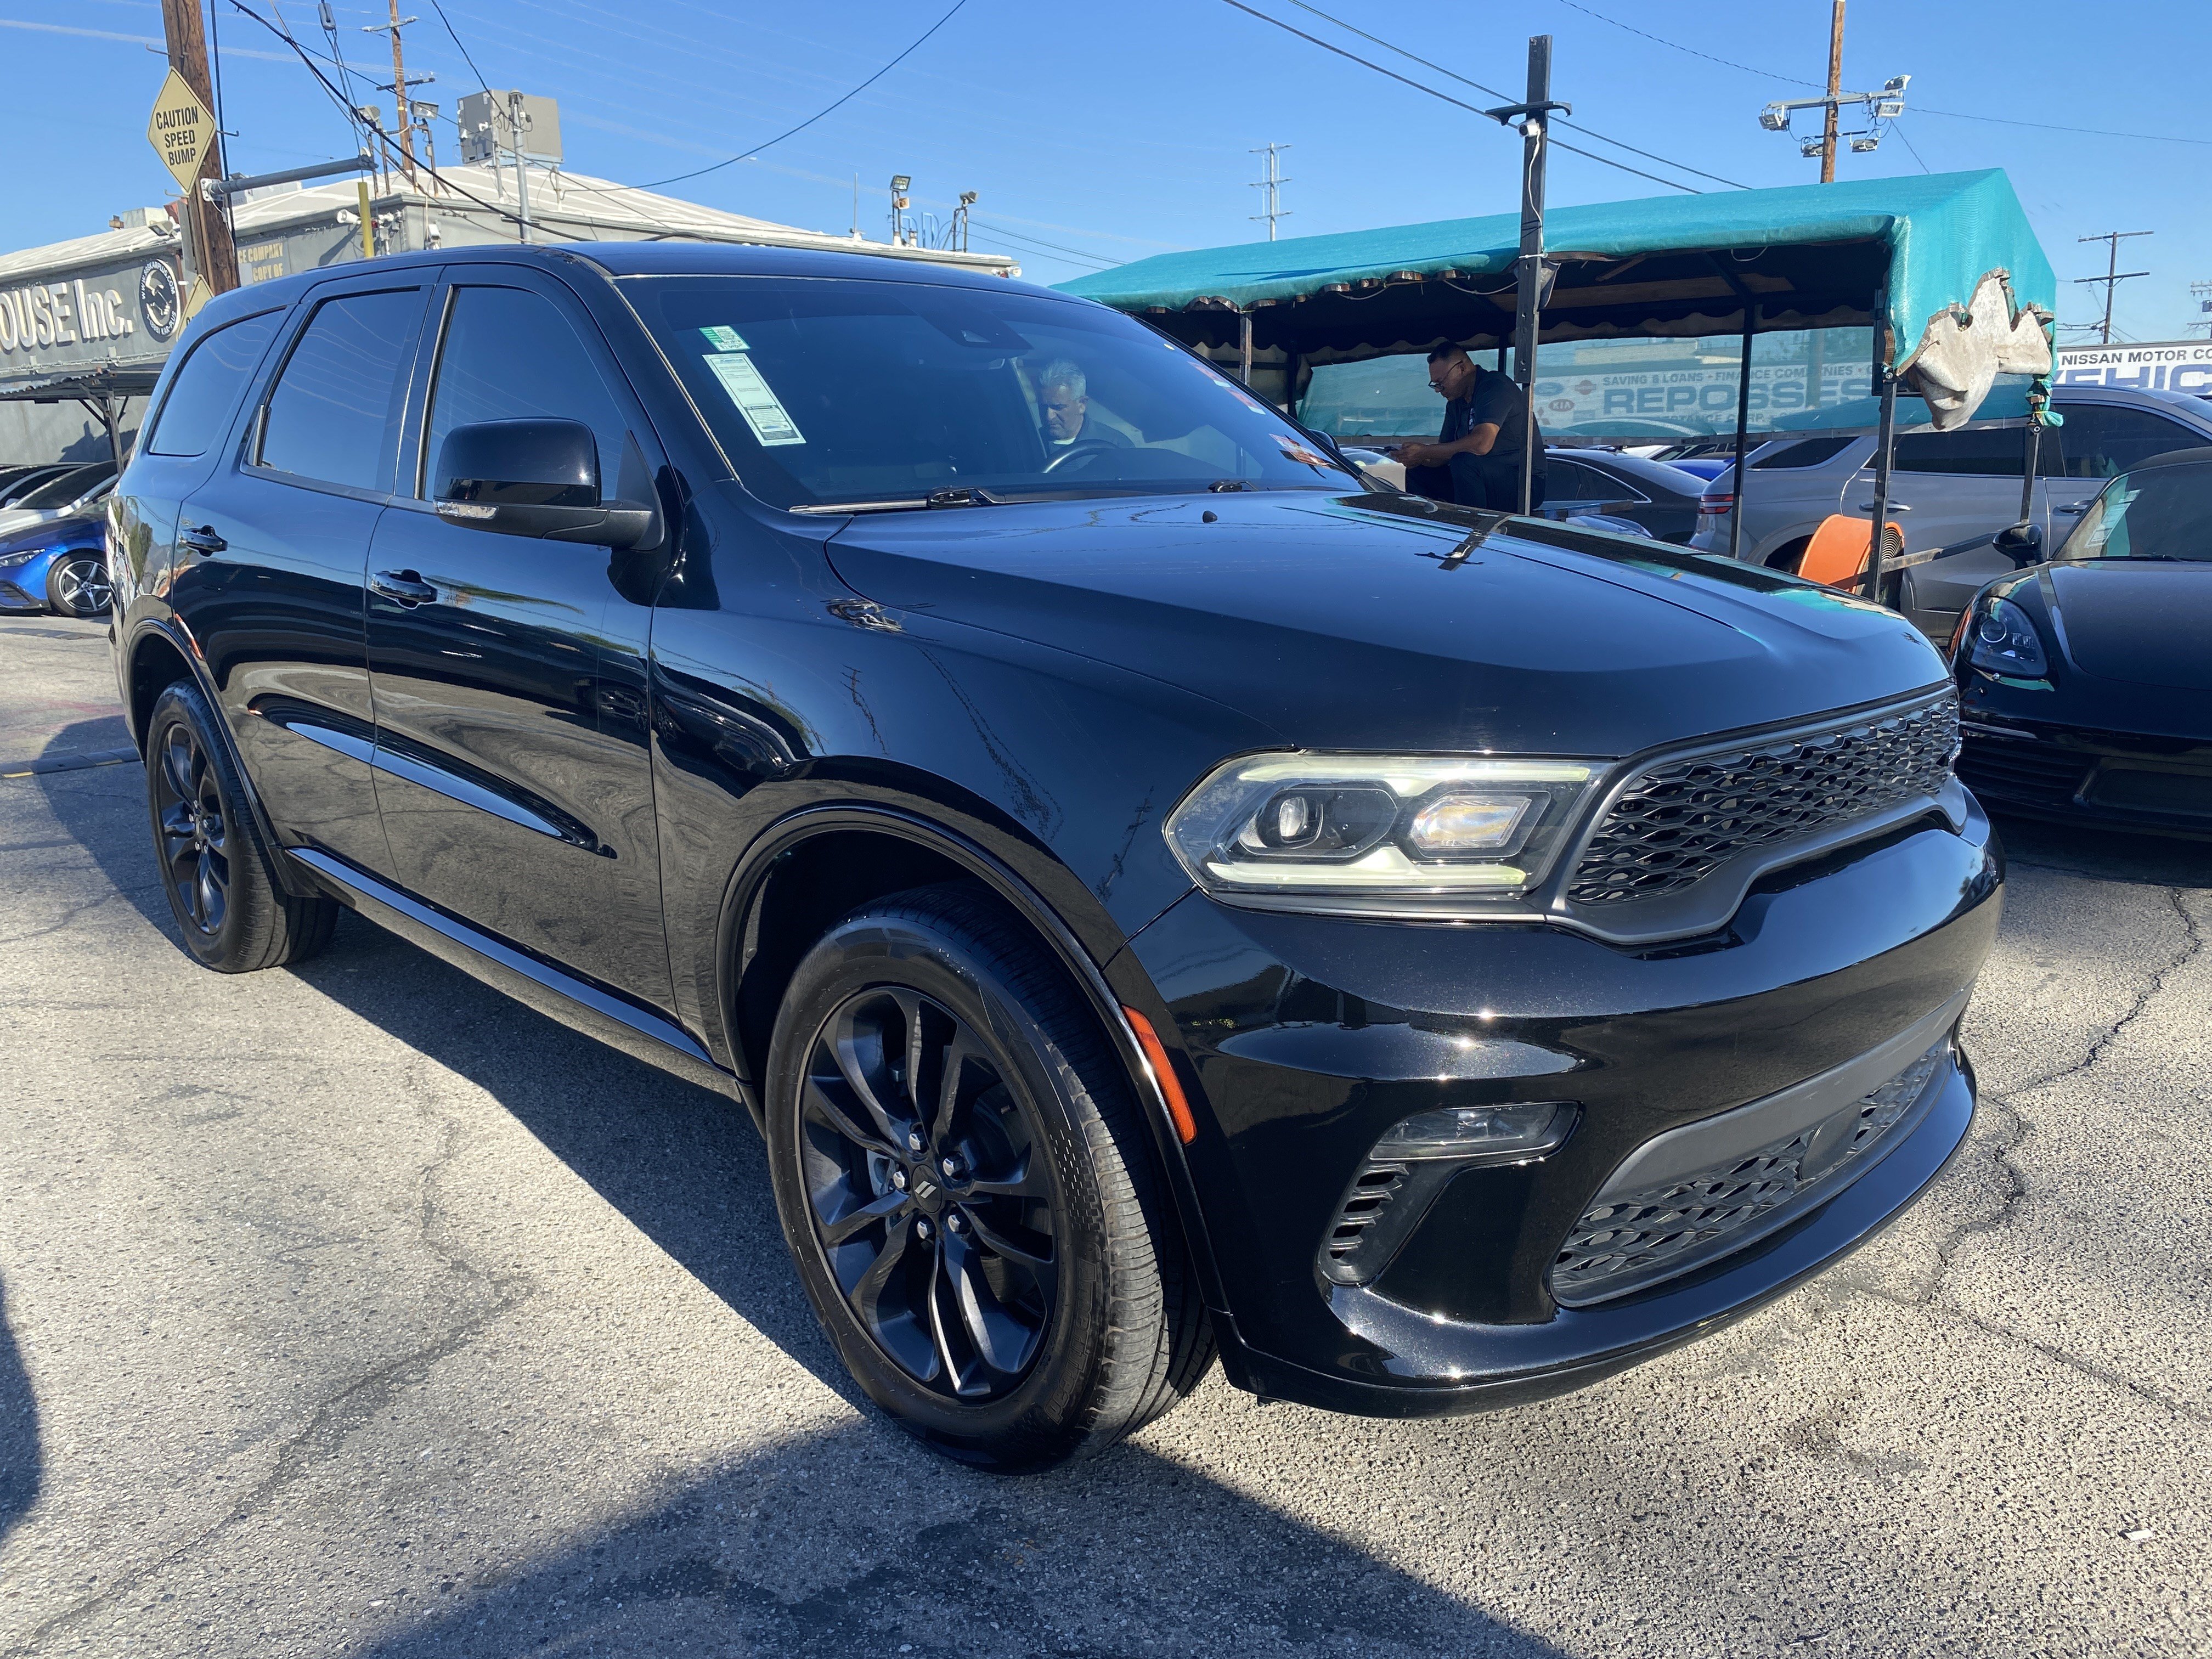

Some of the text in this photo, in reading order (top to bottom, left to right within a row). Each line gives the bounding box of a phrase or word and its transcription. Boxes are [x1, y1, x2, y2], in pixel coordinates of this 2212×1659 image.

[156, 106, 199, 129] CAUTION
[165, 129, 195, 148] SPEED
[168, 148, 196, 166] BUMP
[248, 242, 283, 262] COMPANY
[253, 263, 283, 281] COPY OF
[74, 279, 133, 338] Inc.
[2062, 352, 2123, 365] NISSAN
[2128, 349, 2187, 363] MOTOR
[1603, 374, 1647, 386] SAVING
[1663, 373, 1703, 383] LOANS
[1775, 365, 1853, 378] COMNIES
[1552, 401, 1571, 409] KIA
